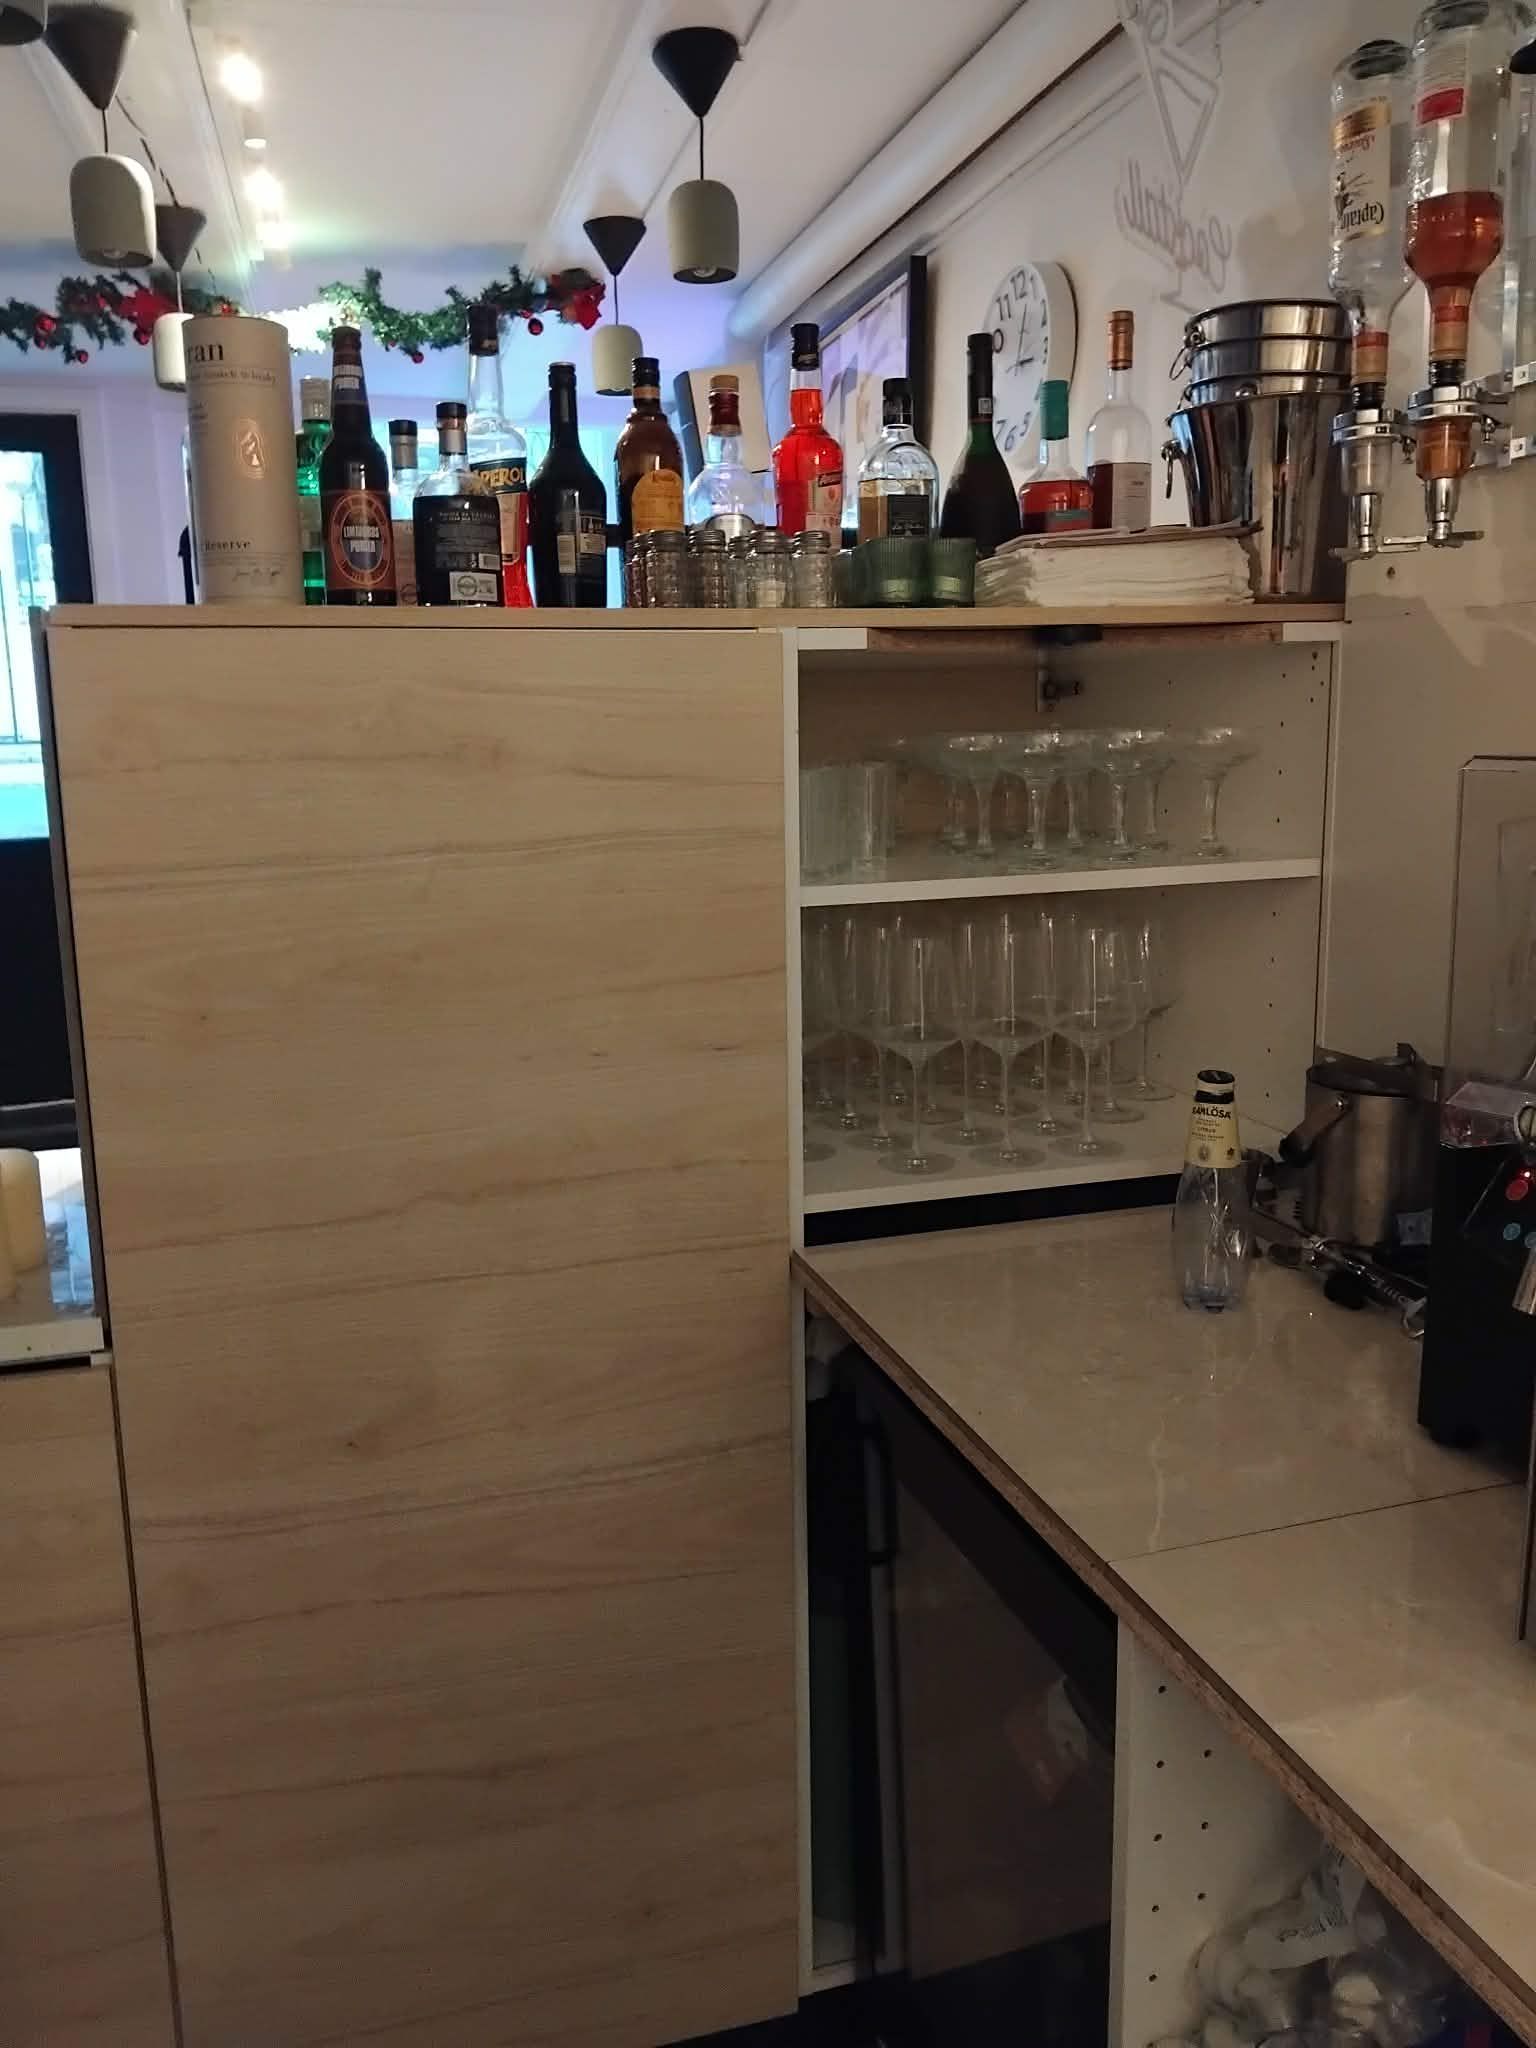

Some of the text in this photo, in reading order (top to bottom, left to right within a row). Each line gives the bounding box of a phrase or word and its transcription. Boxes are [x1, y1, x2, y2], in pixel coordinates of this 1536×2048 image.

[1010, 269, 1028, 301] 12
[995, 293, 1012, 321] 11
[992, 328, 1004, 354] 0
[995, 418, 1008, 440] 7
[1004, 425, 1016, 452] 6
